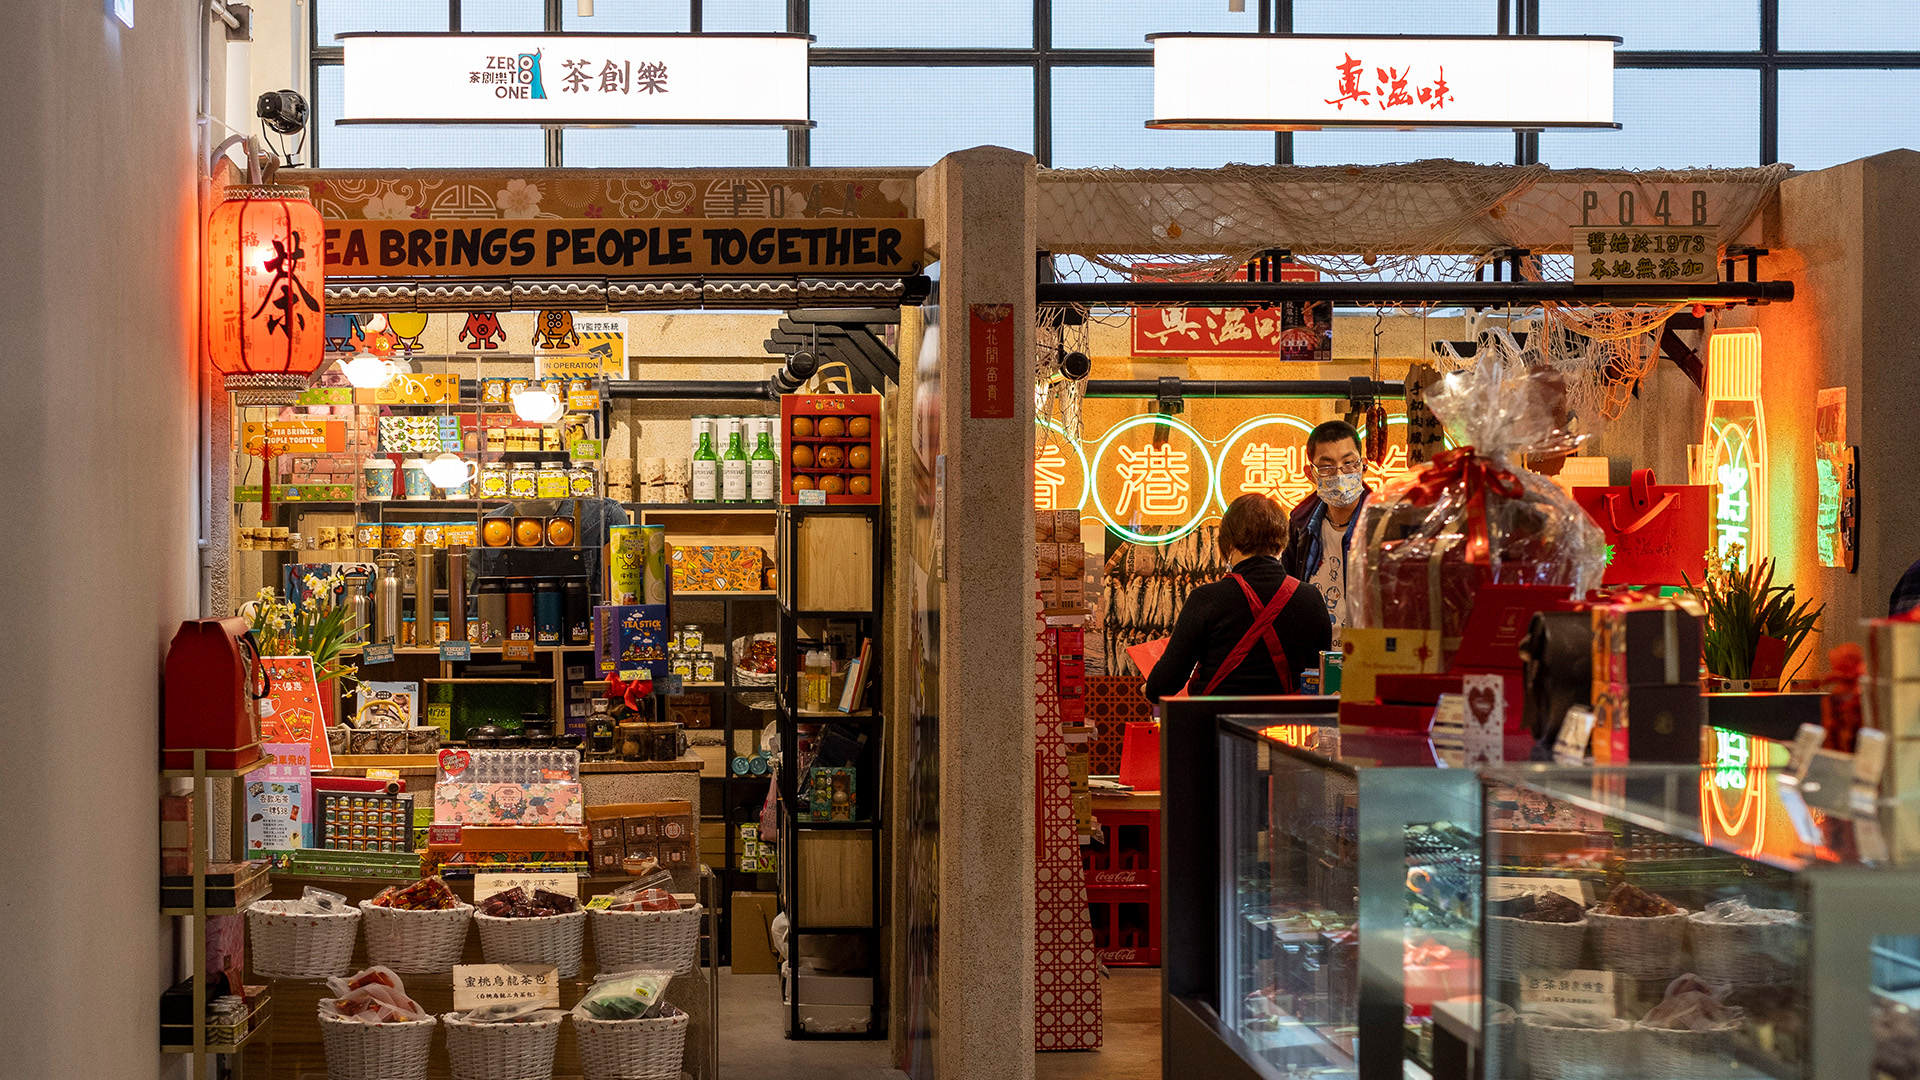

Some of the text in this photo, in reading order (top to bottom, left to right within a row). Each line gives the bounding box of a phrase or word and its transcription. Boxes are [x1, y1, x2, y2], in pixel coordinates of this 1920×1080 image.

[469, 72, 507, 84] 茶創樂
[561, 59, 669, 95] 茶創樂
[1324, 52, 1454, 110] 真滋味
[495, 86, 529, 99] ONE
[243, 231, 260, 247] 福
[324, 229, 369, 266] EA
[546, 227, 692, 267] PEOPLE
[703, 227, 903, 266] TOGETHER
[1588, 232, 1705, 255] 醬始於1973
[1590, 258, 1704, 280] 本地無添加
[251, 231, 321, 340] 茶
[574, 322, 619, 331] CTV監控系統
[986, 328, 998, 400] 花開富貴
[260, 795, 290, 804] 各款名茶
[464, 974, 547, 987] 蜜桃烏龍茶包
